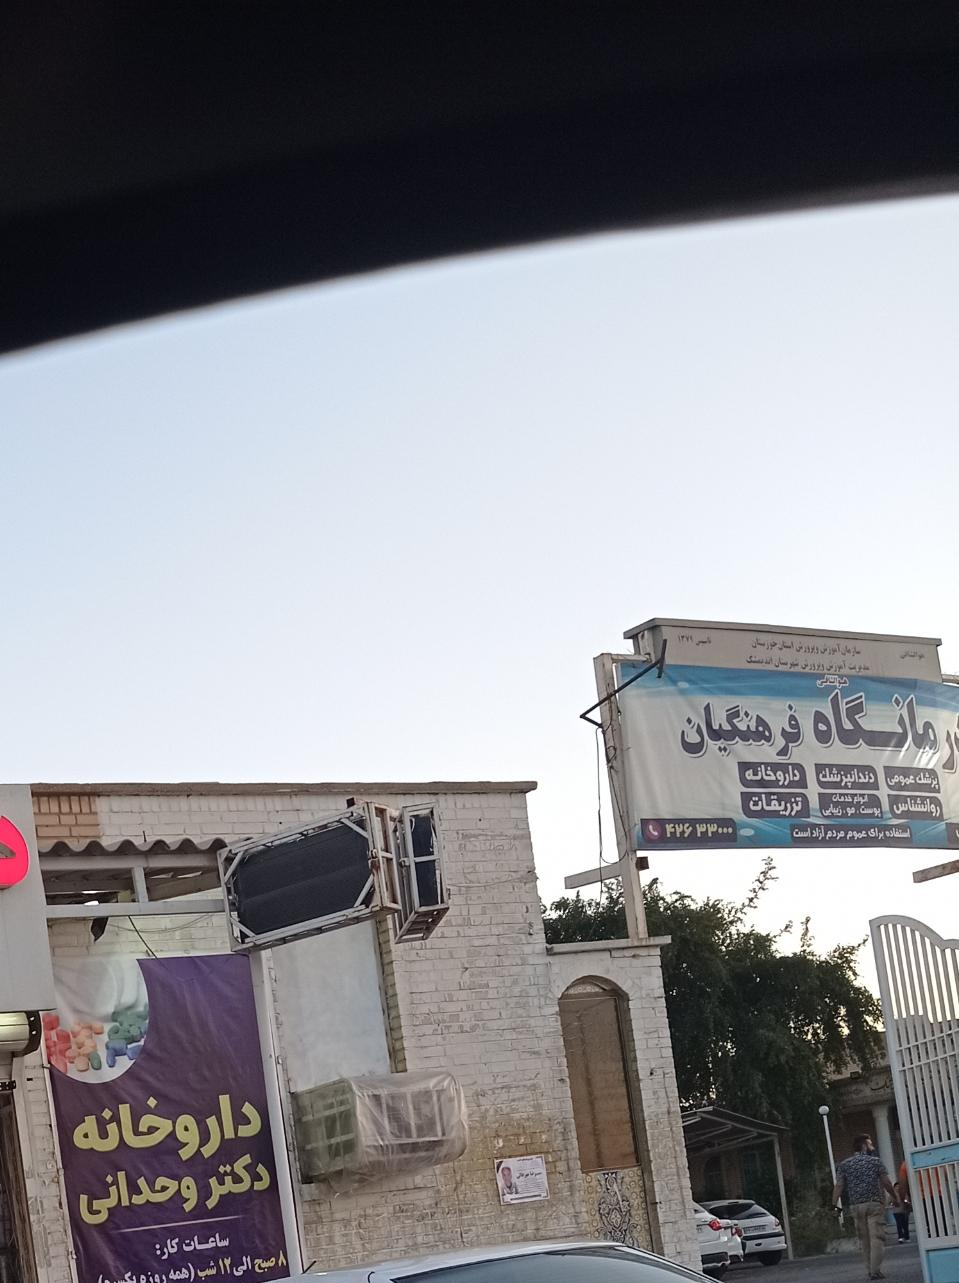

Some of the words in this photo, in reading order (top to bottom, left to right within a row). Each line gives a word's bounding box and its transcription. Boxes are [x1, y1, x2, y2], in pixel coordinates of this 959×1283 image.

[680, 702, 803, 760] فرهنگیان
[744, 764, 800, 786] داروخانه
[819, 767, 875, 788] دندانپزشک
[887, 774, 915, 788] عمومی
[915, 773, 939, 790] پزشک
[749, 794, 802, 816] تزریقات
[893, 797, 940, 817] روانشناس
[665, 823, 692, 837] ۴۲۶
[696, 823, 733, 837] ۳۳۰۰۰
[793, 828, 811, 838] است
[812, 825, 825, 840] آزاد
[826, 830, 846, 840] مردم
[847, 830, 868, 840] عموم
[869, 828, 884, 839] برای
[886, 828, 910, 839] استفاده
[72, 1094, 262, 1160] داروخانه
[205, 1154, 271, 1210] دکتر
[79, 1170, 199, 1226] وحدانی
[155, 1238, 179, 1259] کار:
[183, 1233, 230, 1253] ساعات
[219, 1257, 232, 1275] ۱۲
[233, 1255, 252, 1277] الی
[253, 1256, 276, 1273] صبح
[278, 1250, 287, 1267] ۸
[168, 1262, 195, 1282] (همه
[198, 1261, 217, 1279] شب
